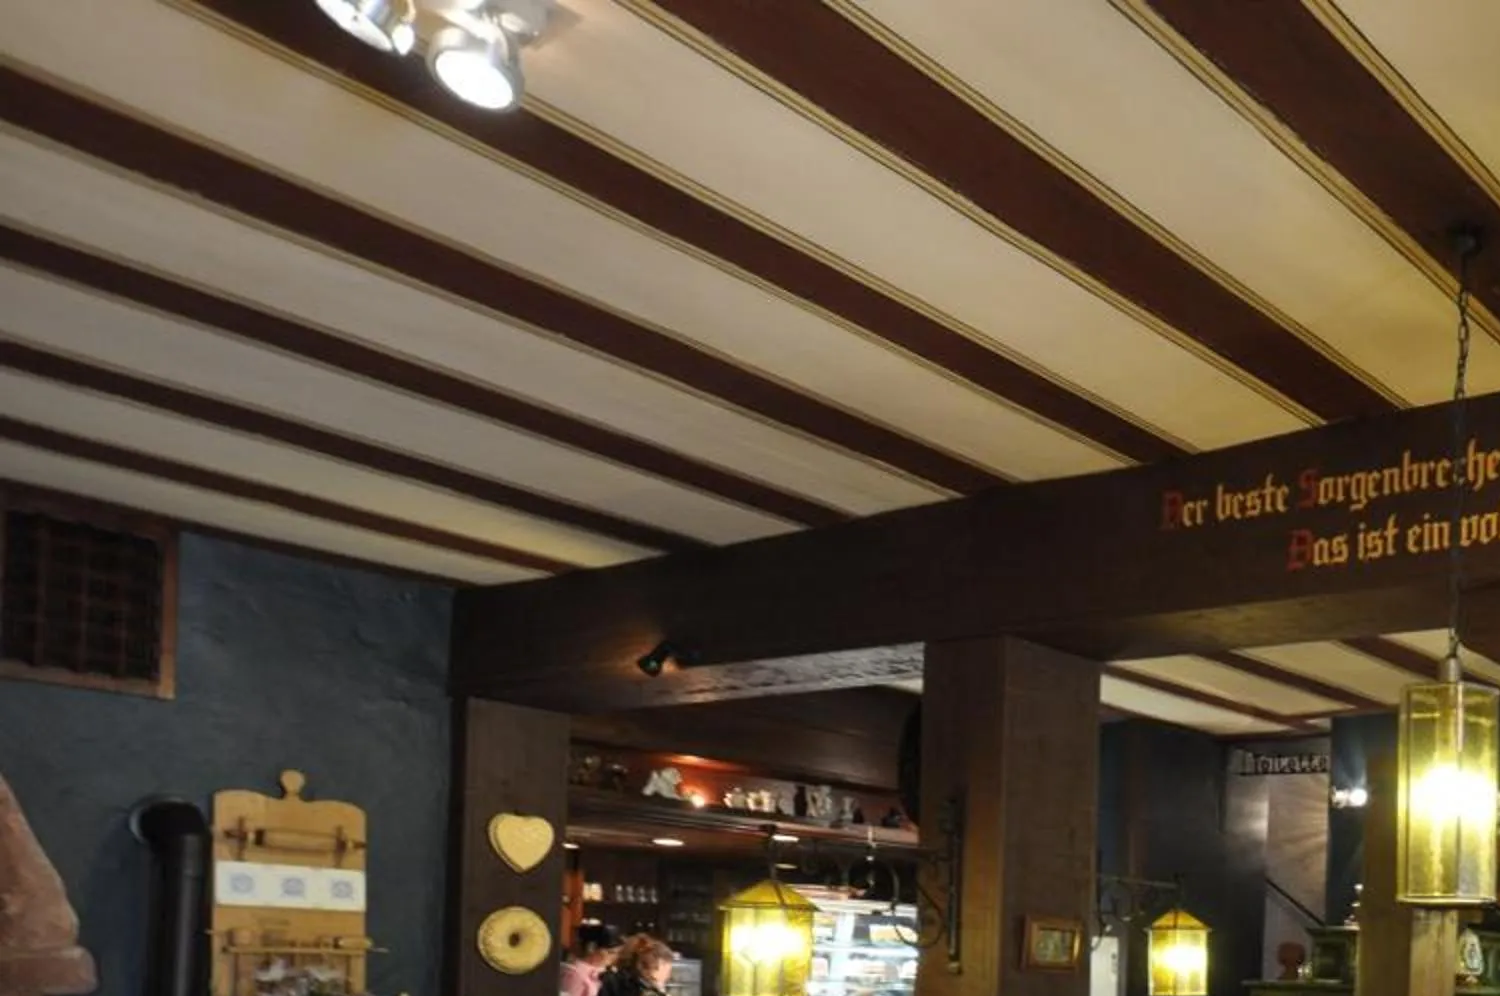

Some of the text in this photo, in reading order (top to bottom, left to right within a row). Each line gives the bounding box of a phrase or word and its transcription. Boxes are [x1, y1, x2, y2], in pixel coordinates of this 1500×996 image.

[1159, 488, 1206, 531] Der
[1215, 473, 1291, 521] beste
[1286, 526, 1350, 572] Das
[1357, 512, 1399, 561] ist
[1406, 513, 1450, 553] ein
